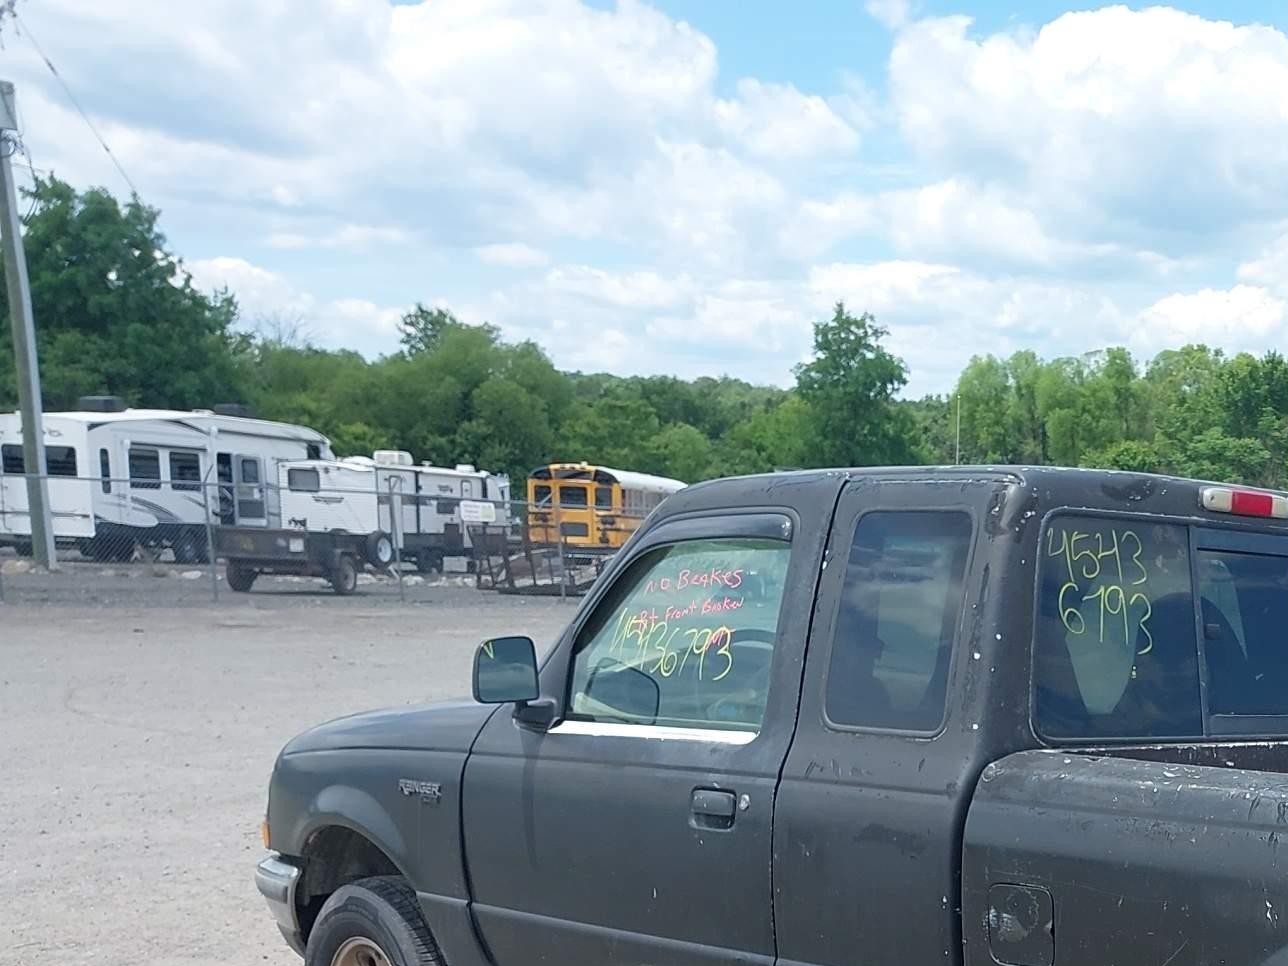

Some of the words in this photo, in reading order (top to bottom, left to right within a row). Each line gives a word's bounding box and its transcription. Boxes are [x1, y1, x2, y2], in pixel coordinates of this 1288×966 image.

[1047, 527, 1148, 585] 4543
[609, 608, 733, 681] 45436793
[1058, 582, 1153, 655] 6793
